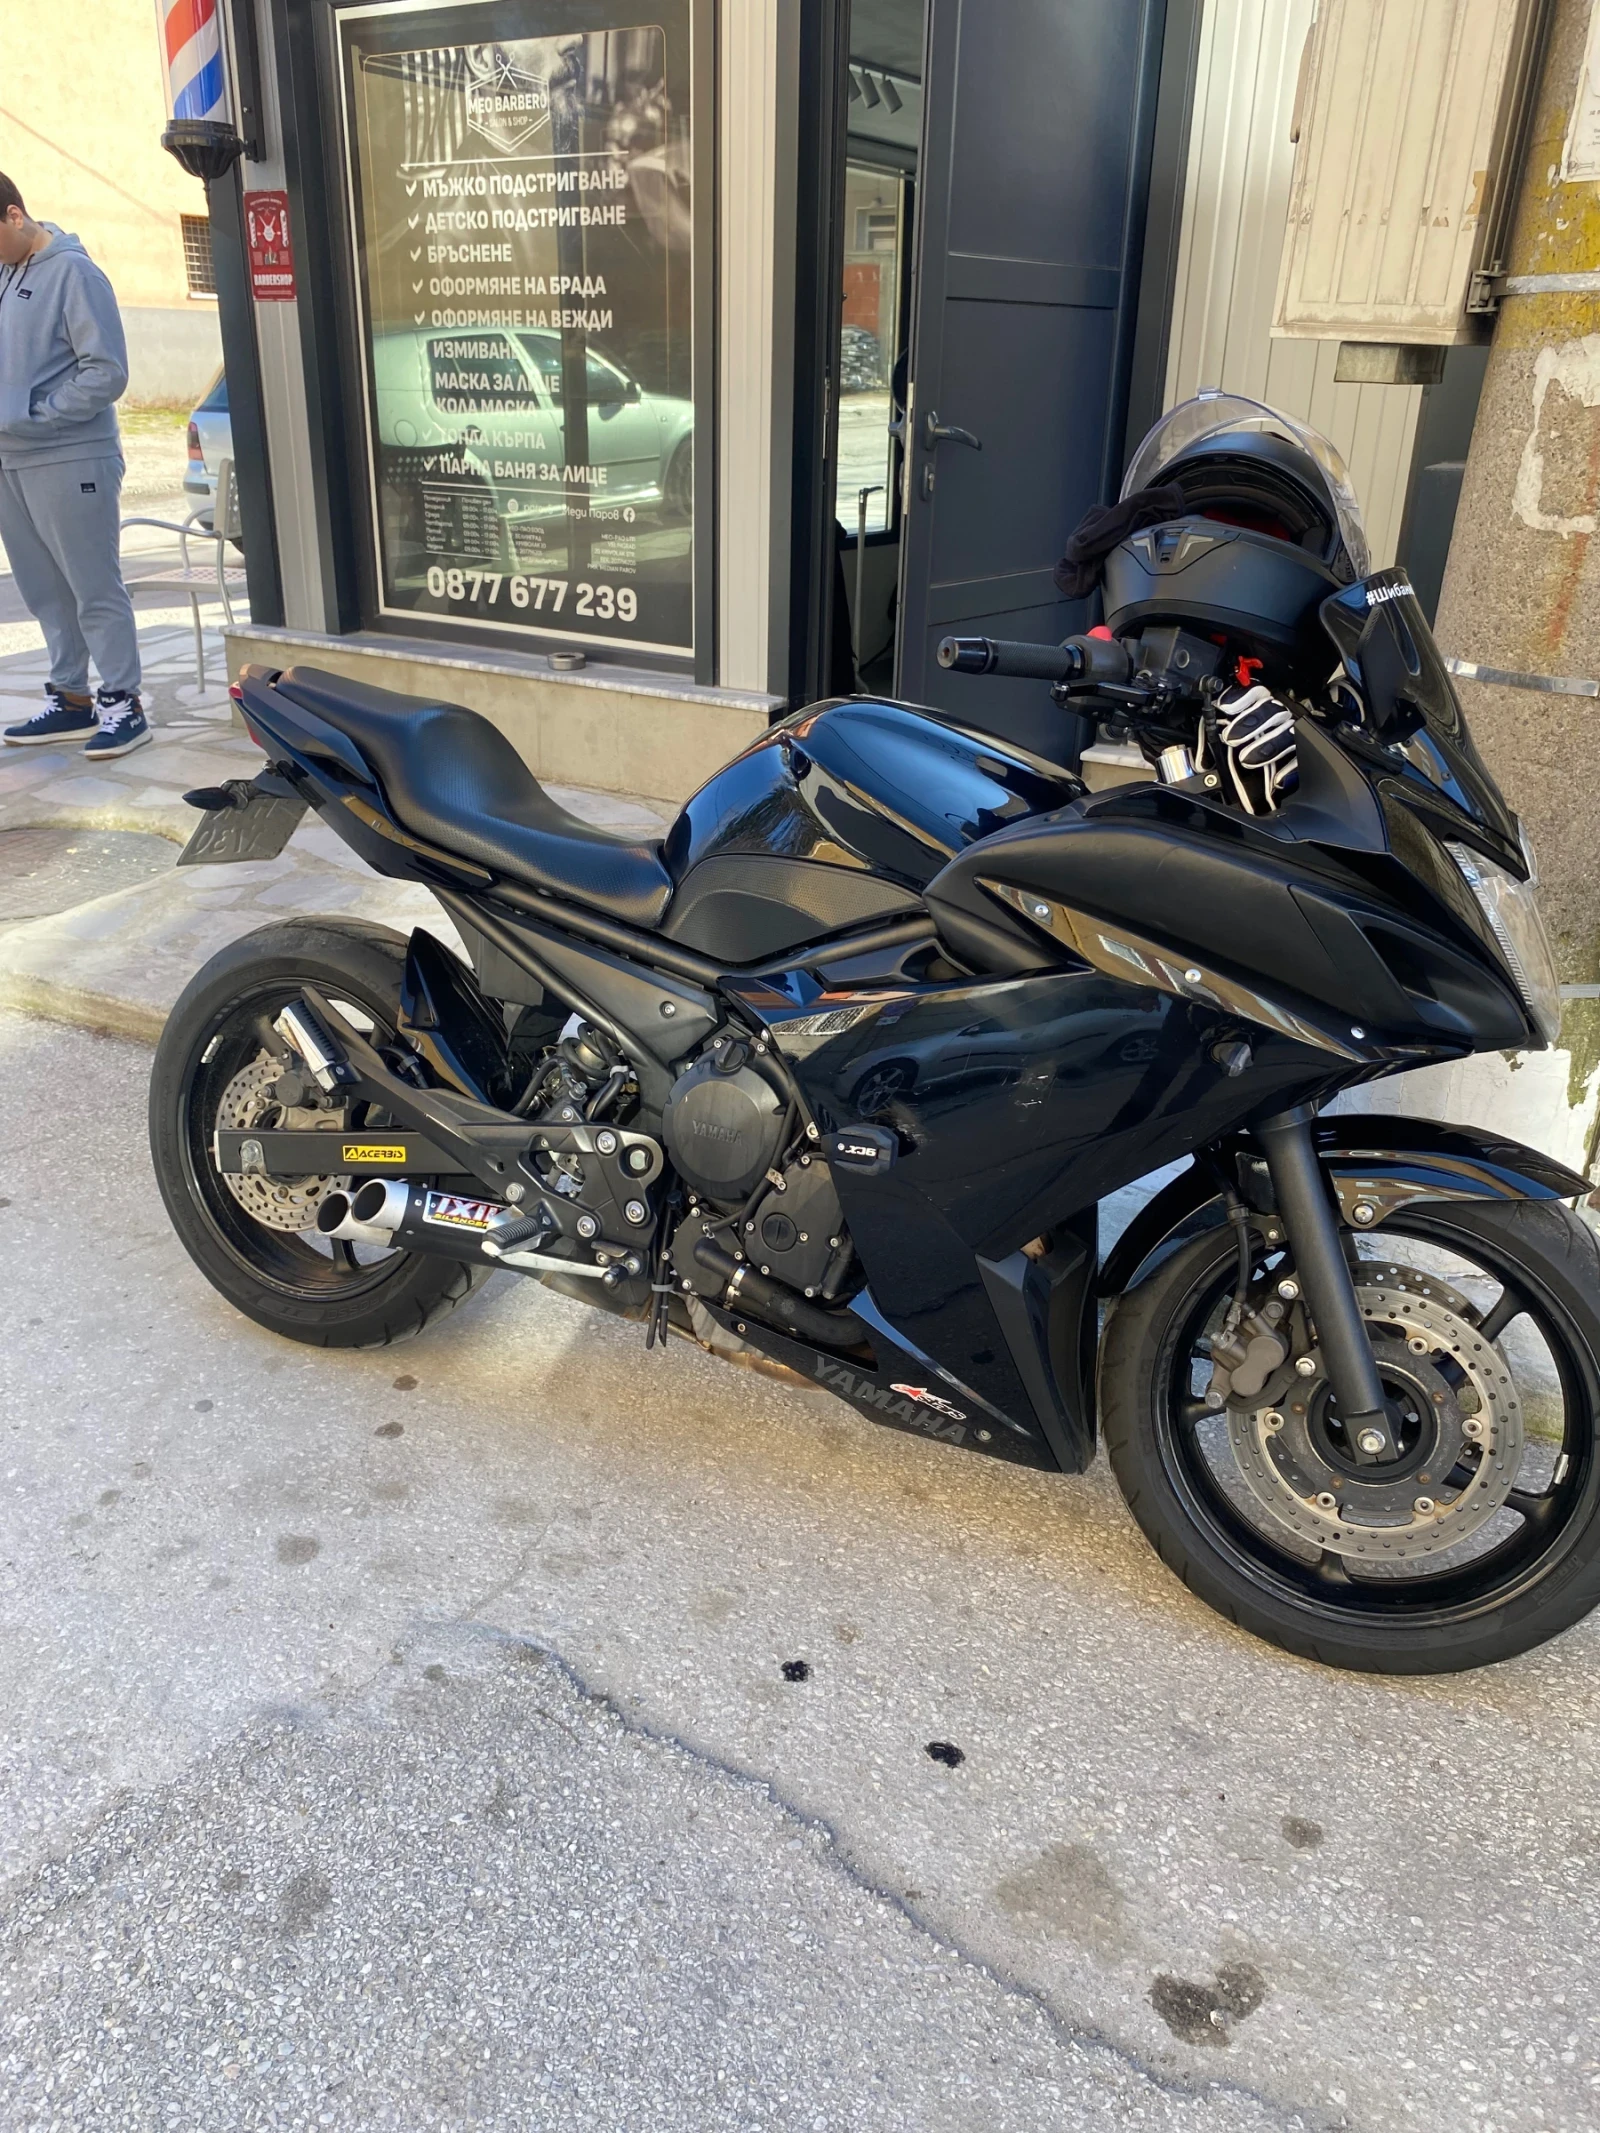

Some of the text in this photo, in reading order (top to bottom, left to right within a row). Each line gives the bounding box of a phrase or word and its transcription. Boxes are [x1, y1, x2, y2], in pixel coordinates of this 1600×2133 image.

[469, 93, 547, 114] MEO BARBERO
[513, 116, 528, 126] SHOP
[423, 169, 626, 198] МЪЖКО ПОДСТРИГВАНЕ
[425, 205, 626, 234] ДЕТСКО ПОДСТРИГВАНЕ
[427, 243, 512, 263] БРЪСНЕНЕ
[429, 275, 607, 298] ОФОРМЯНЕ НА БРАДА
[431, 308, 613, 332] ОФОРМЯНЕ НА ВЕЖДИ
[435, 372, 491, 391] МАСКА
[493, 373, 514, 391] ЗА
[436, 397, 537, 417] КОЛА МАСКА
[492, 431, 546, 450] КЪРПА
[494, 460, 536, 480] БАНЯ
[539, 463, 560, 482] ЗА
[563, 465, 608, 487] ЛИЦЕ
[427, 566, 638, 622] 0877 677 239
[692, 1119, 742, 1146] YAMAHA
[358, 1149, 404, 1159] ACERBIS
[813, 1355, 967, 1444] YAMAHA
